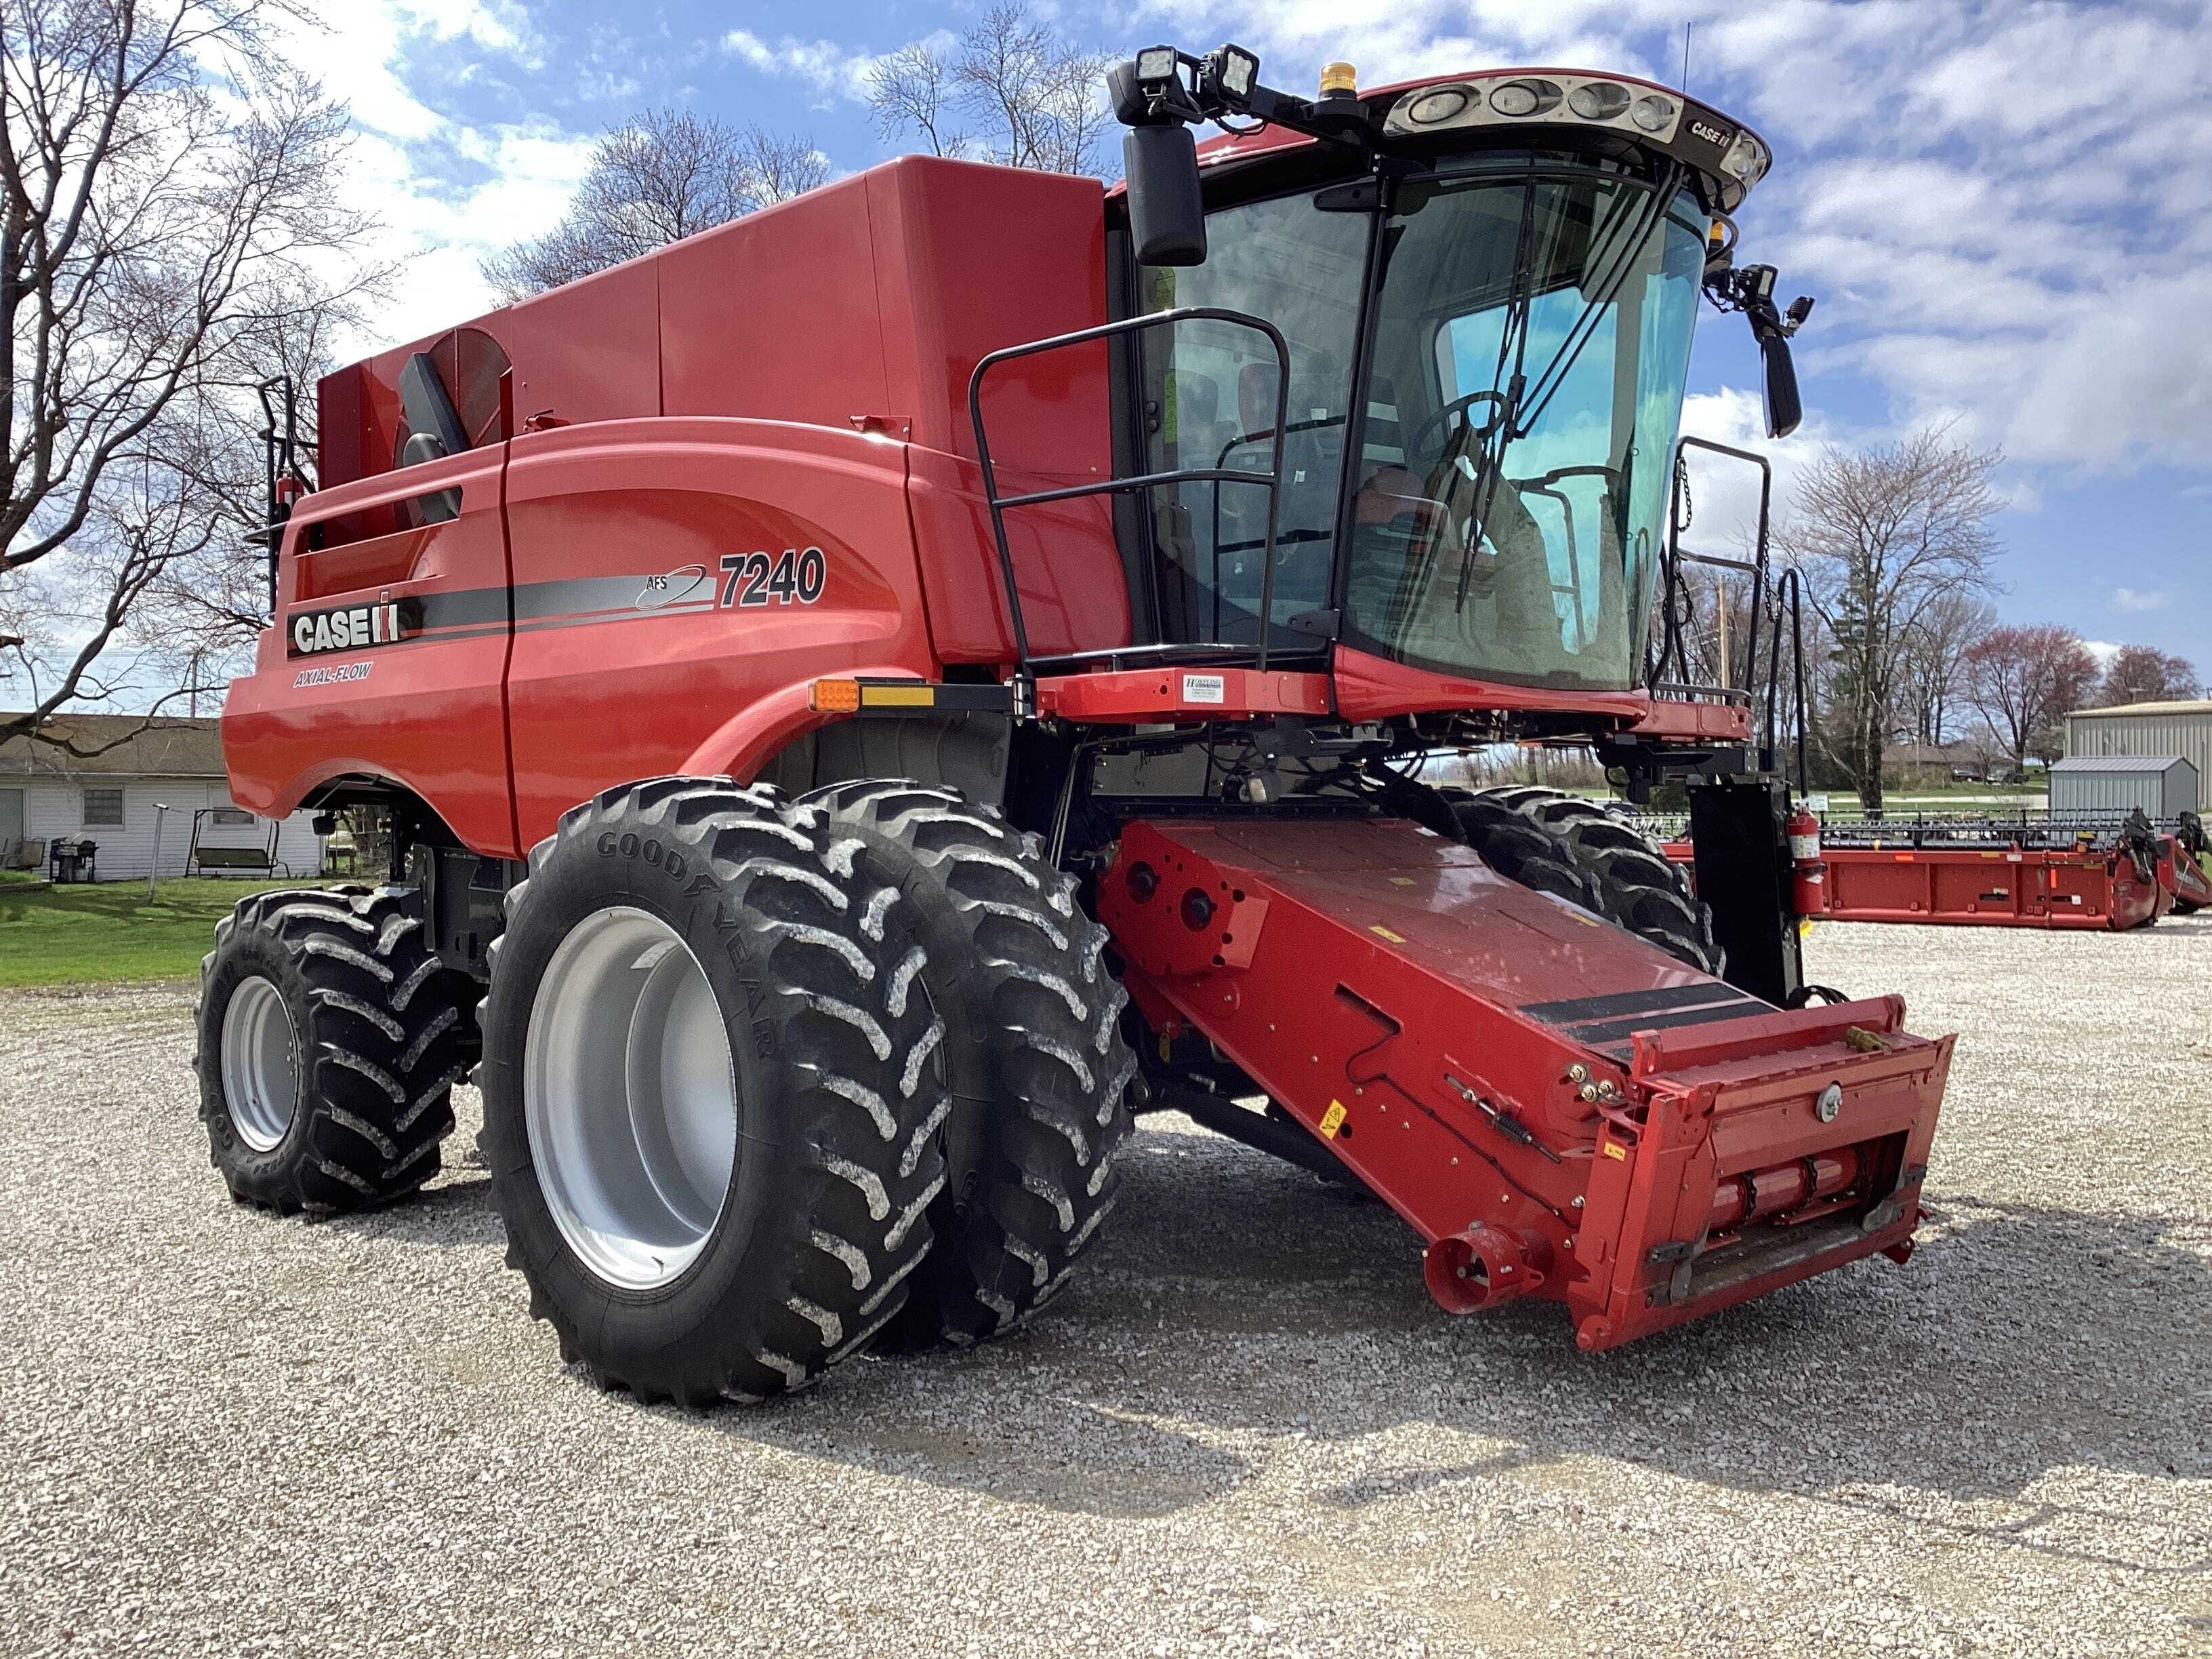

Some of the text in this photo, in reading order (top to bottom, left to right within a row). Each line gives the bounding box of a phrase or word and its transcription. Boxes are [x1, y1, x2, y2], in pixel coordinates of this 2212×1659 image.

[1692, 121, 1721, 143] CASE
[645, 575, 668, 590] AFS
[719, 546, 826, 609] 7240
[294, 608, 369, 653] CASE
[293, 661, 373, 689] AXIAL-FLOW
